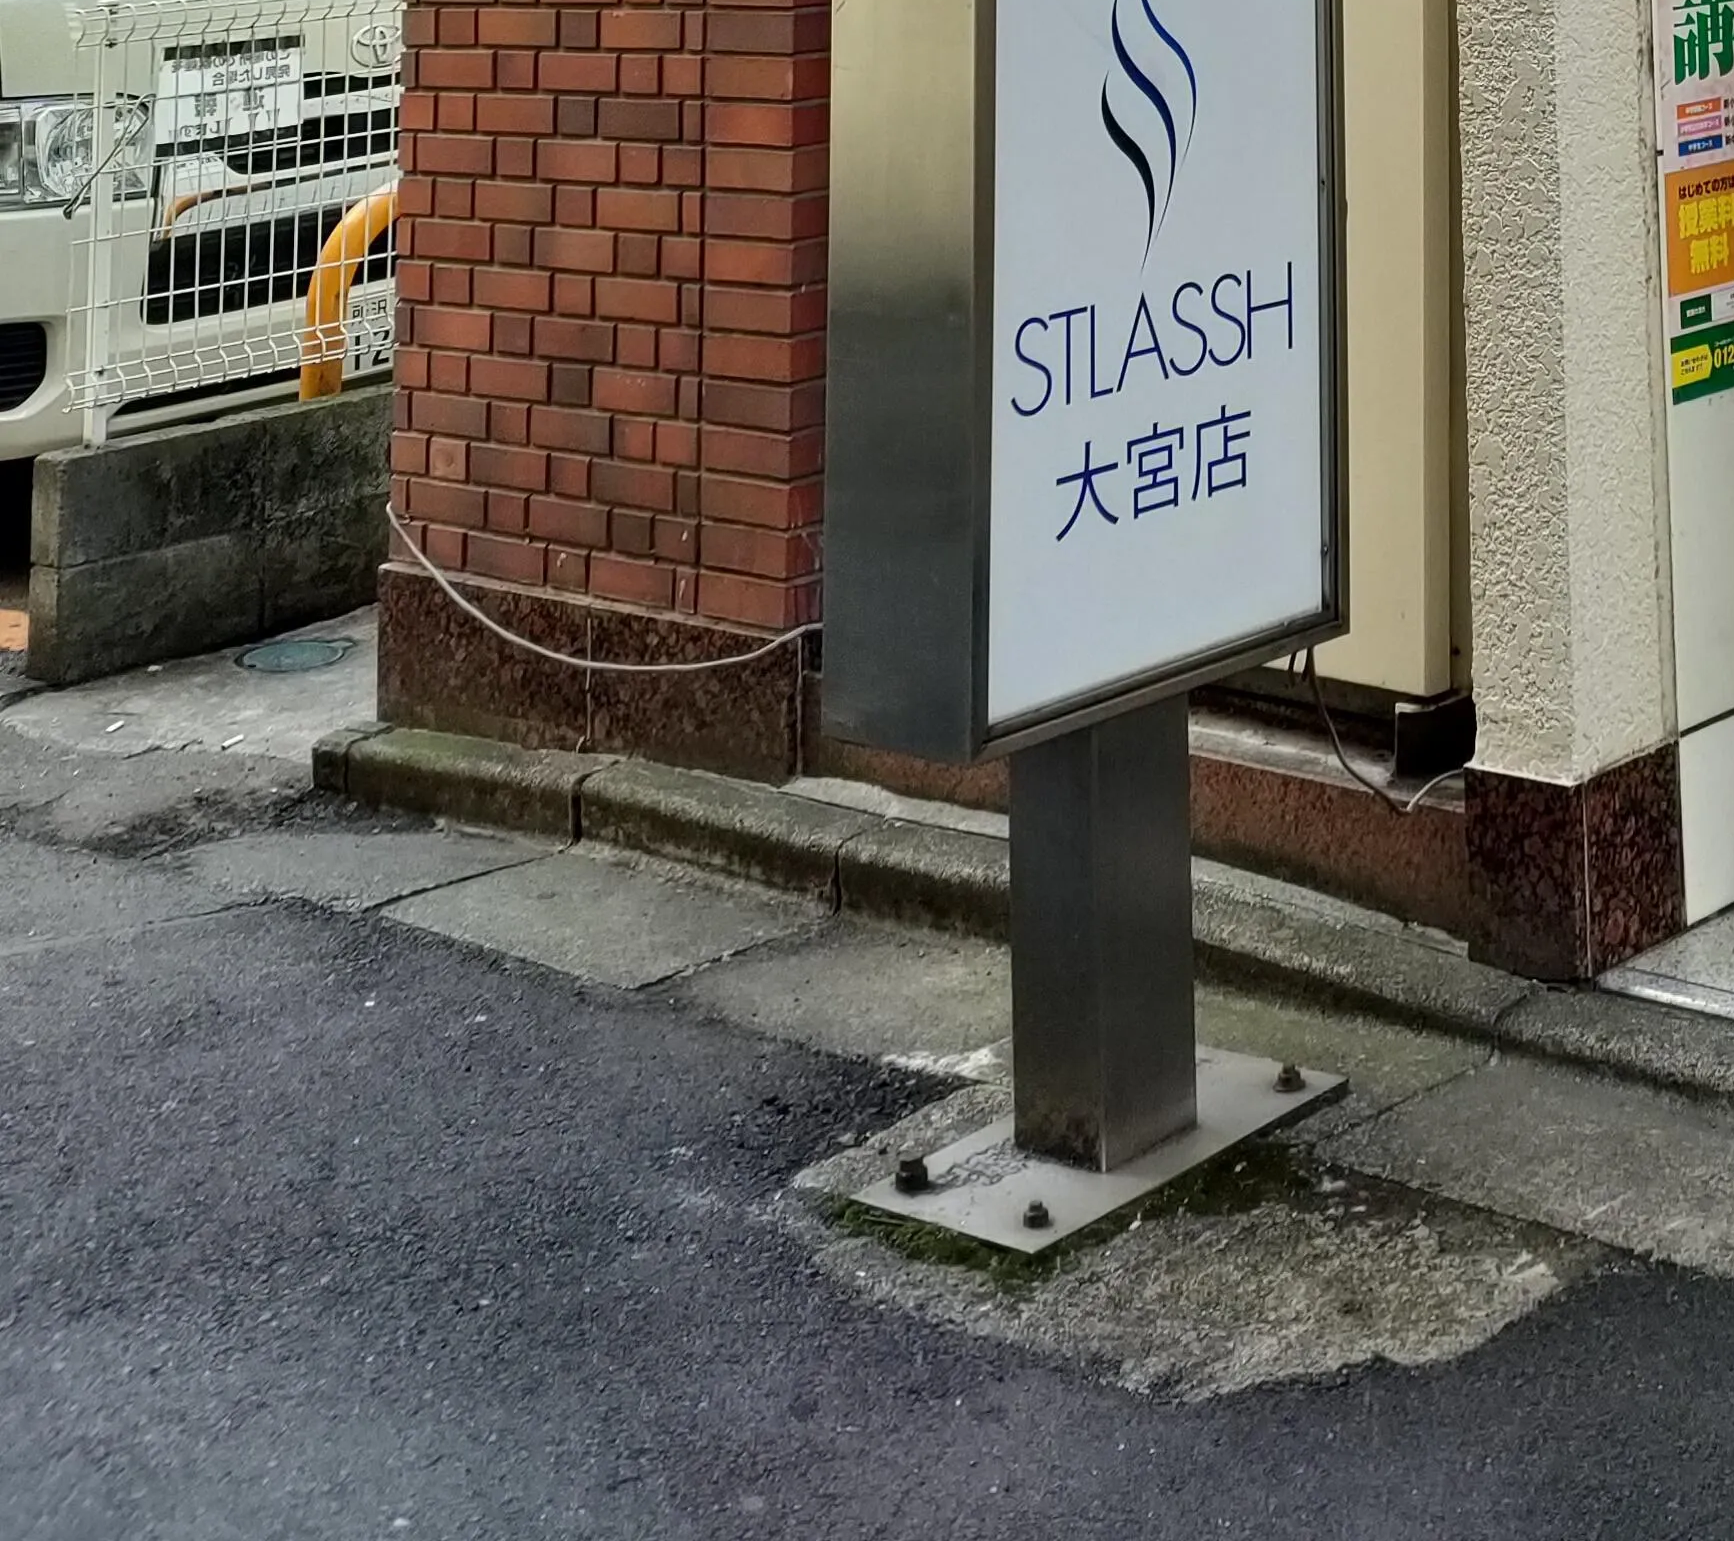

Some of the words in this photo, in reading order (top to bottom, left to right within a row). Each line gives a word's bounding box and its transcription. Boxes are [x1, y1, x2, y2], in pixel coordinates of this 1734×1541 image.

[1690, 232, 1731, 275] 無料
[1010, 260, 1294, 417] STLASSH
[1055, 404, 1253, 544] 大宮店
